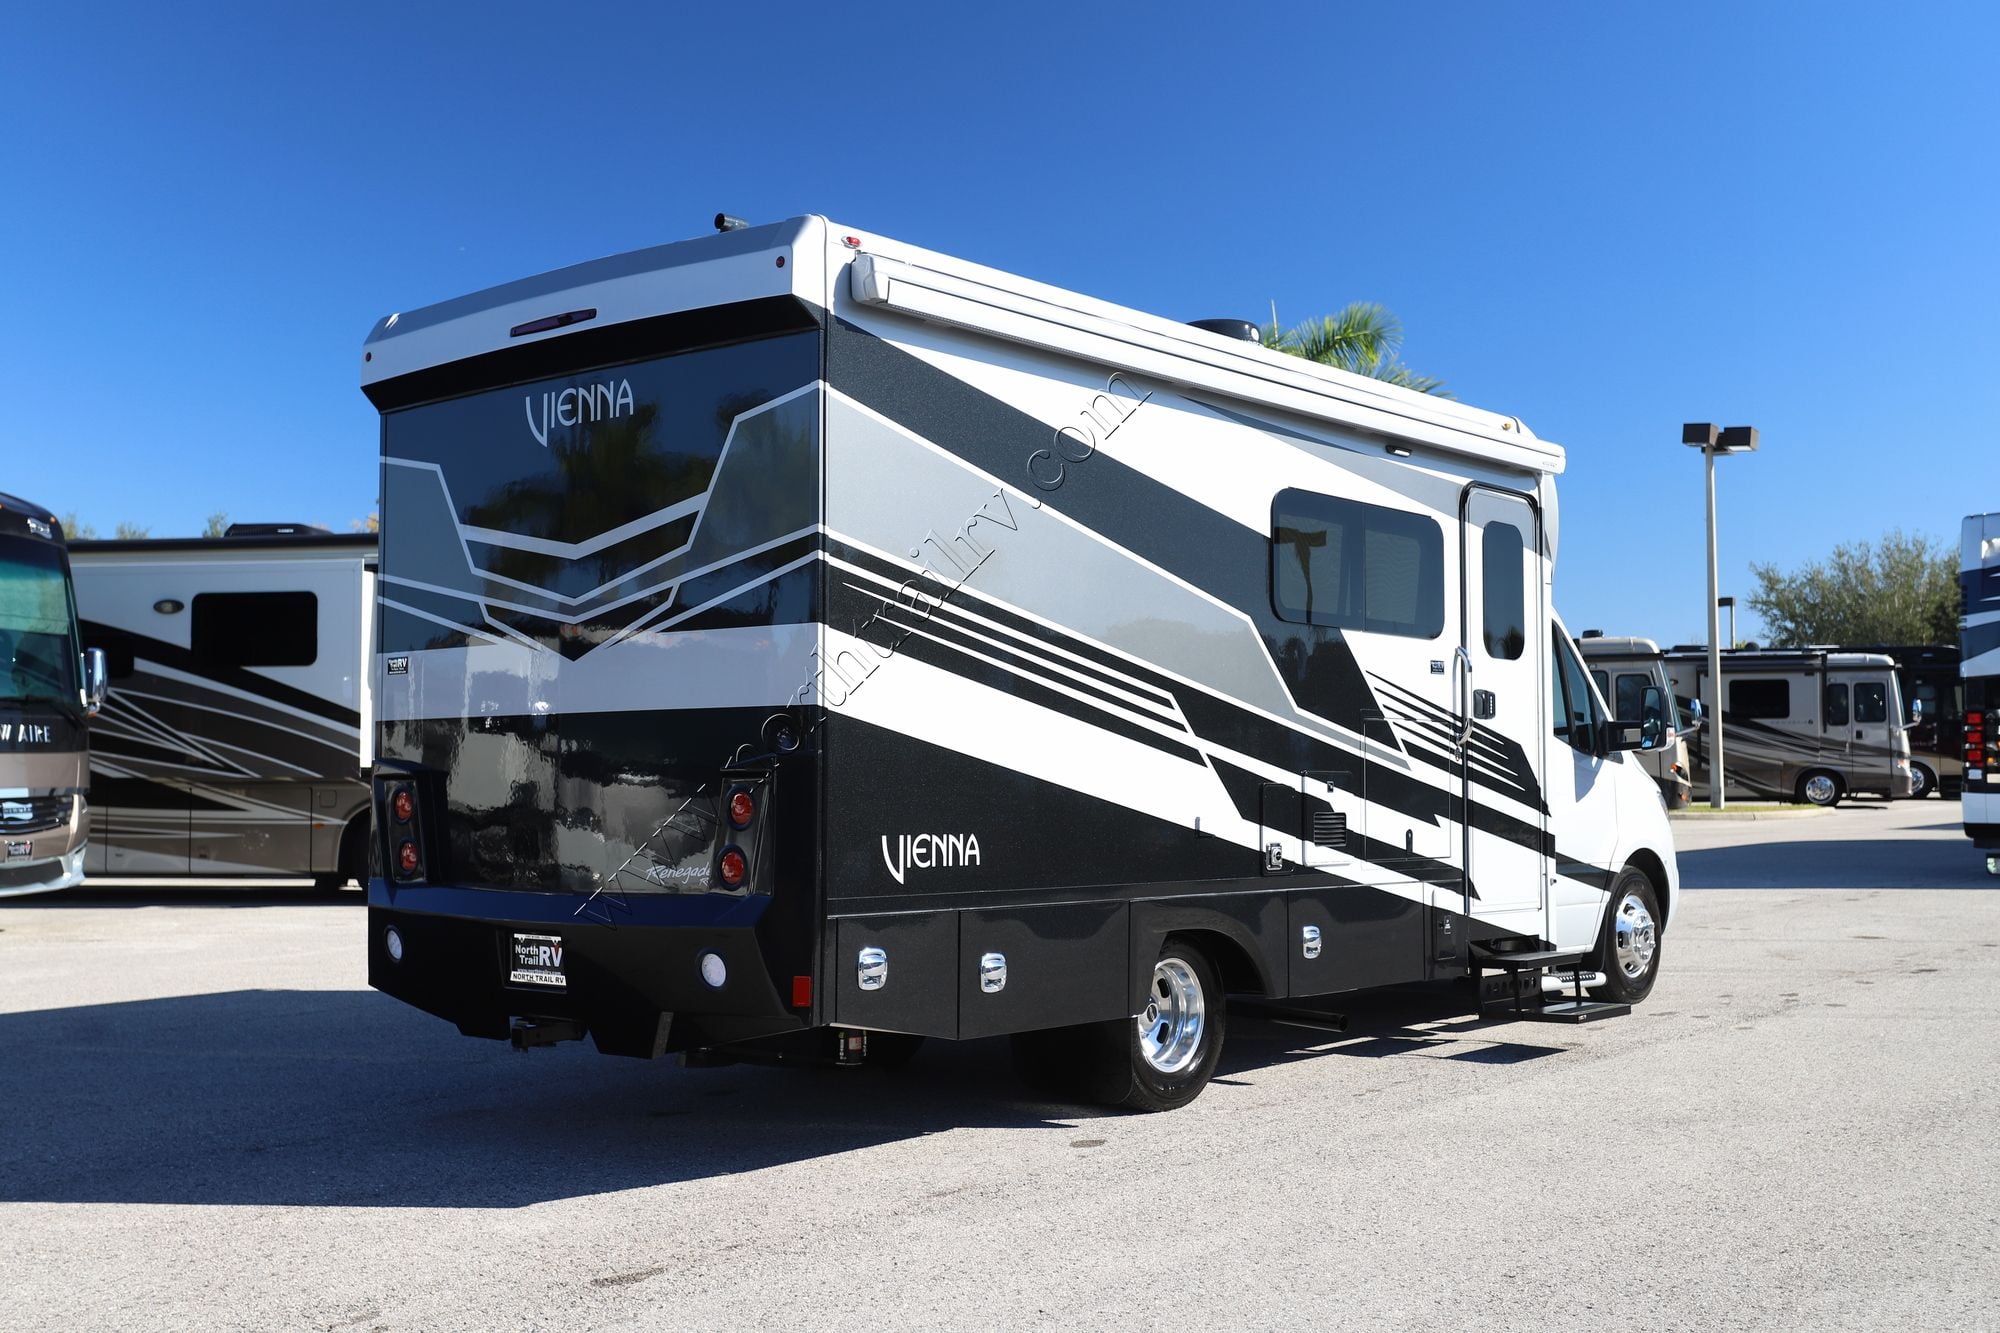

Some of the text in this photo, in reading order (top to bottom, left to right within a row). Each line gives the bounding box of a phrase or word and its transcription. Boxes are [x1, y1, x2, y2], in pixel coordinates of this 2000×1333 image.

[525, 379, 634, 447] VIENNA
[18, 724, 51, 743] AIRE
[881, 833, 981, 885] VIENNA
[515, 944, 538, 955] North
[539, 945, 562, 967] RV
[519, 955, 538, 965] Trail
[513, 973, 533, 981] NORTH
[536, 975, 554, 983] TRAIL
